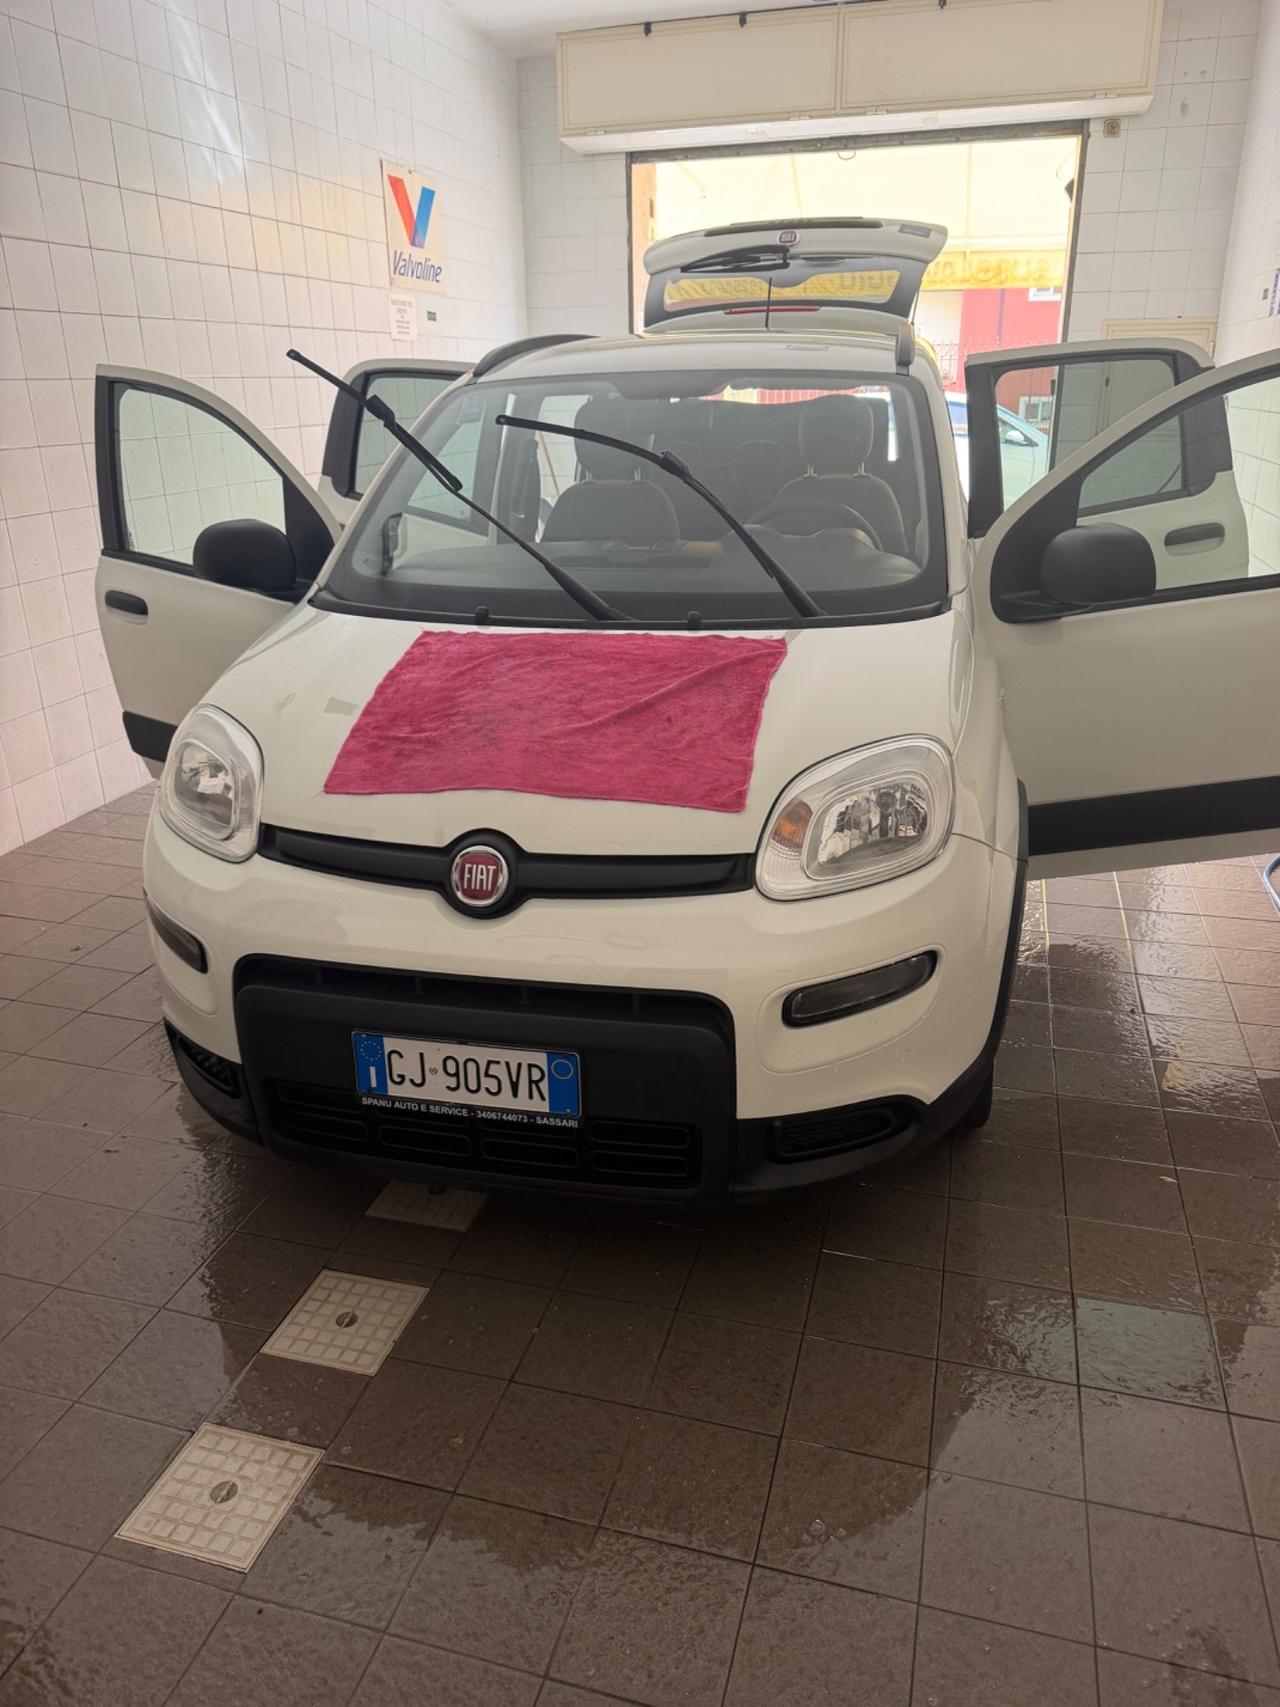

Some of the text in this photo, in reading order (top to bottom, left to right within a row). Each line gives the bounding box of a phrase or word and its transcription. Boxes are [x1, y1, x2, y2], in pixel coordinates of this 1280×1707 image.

[392, 250, 443, 283] Valvoline
[464, 863, 497, 891] FIAT
[387, 1049, 547, 1102] GJ 905VR
[361, 1096, 393, 1109] SPANU
[393, 1101, 420, 1112] AUTO
[420, 1104, 428, 1113] E
[428, 1104, 469, 1118] SERVICE
[476, 1109, 529, 1124] 3406744073
[535, 1115, 579, 1129] SASSARI
